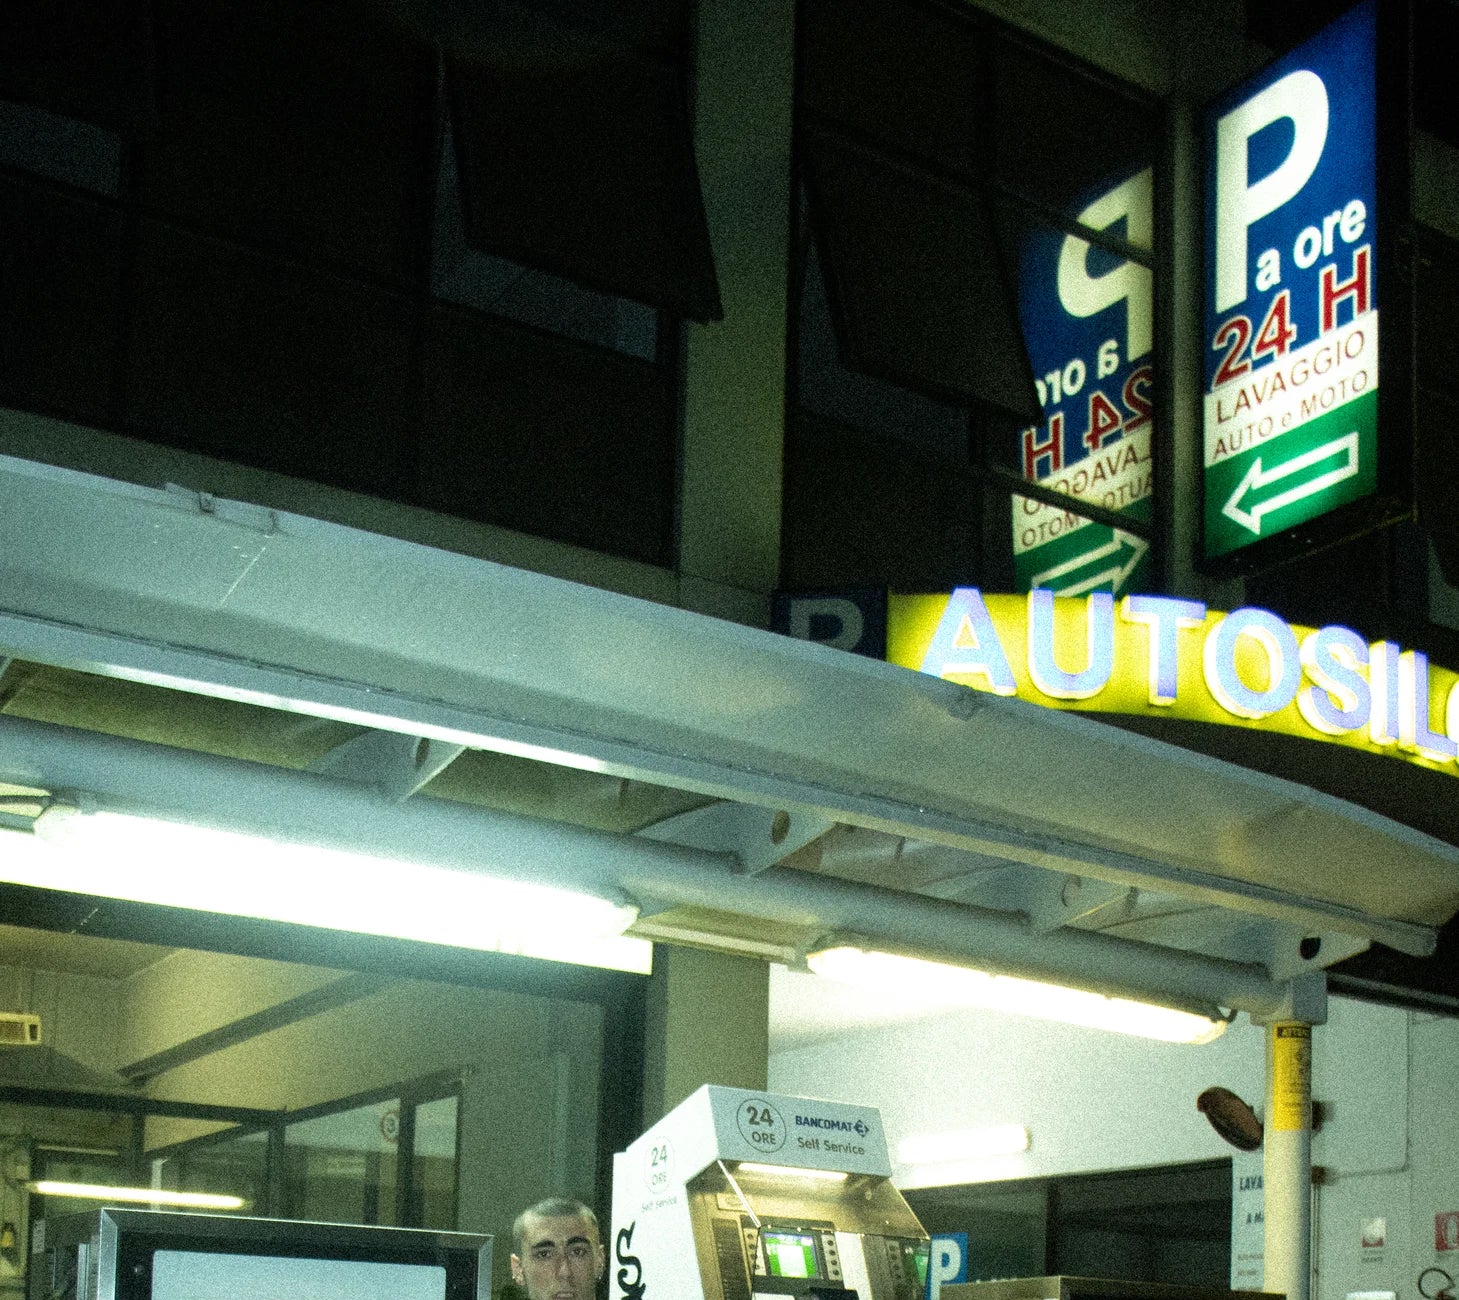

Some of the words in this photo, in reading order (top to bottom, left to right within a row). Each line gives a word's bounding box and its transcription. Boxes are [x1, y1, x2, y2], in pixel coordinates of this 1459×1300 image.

[1216, 69, 1330, 314] P
[1255, 248, 1281, 292] a
[1293, 199, 1367, 269] ore
[1212, 288, 1298, 392] 24
[1319, 243, 1372, 341] H
[1213, 416, 1275, 460] AUTO
[1280, 411, 1293, 429] e
[1300, 369, 1369, 420] MOTO
[1216, 330, 1365, 424] LAVAGGIO
[919, 585, 1459, 764] AUTOSIL
[746, 1105, 775, 1127] 24
[751, 1131, 776, 1145] ORE
[795, 1115, 853, 1132] BANCOMAT
[797, 1137, 820, 1151] Self
[825, 1140, 865, 1155] Service
[651, 1144, 668, 1168] 24
[930, 1239, 961, 1300] P
